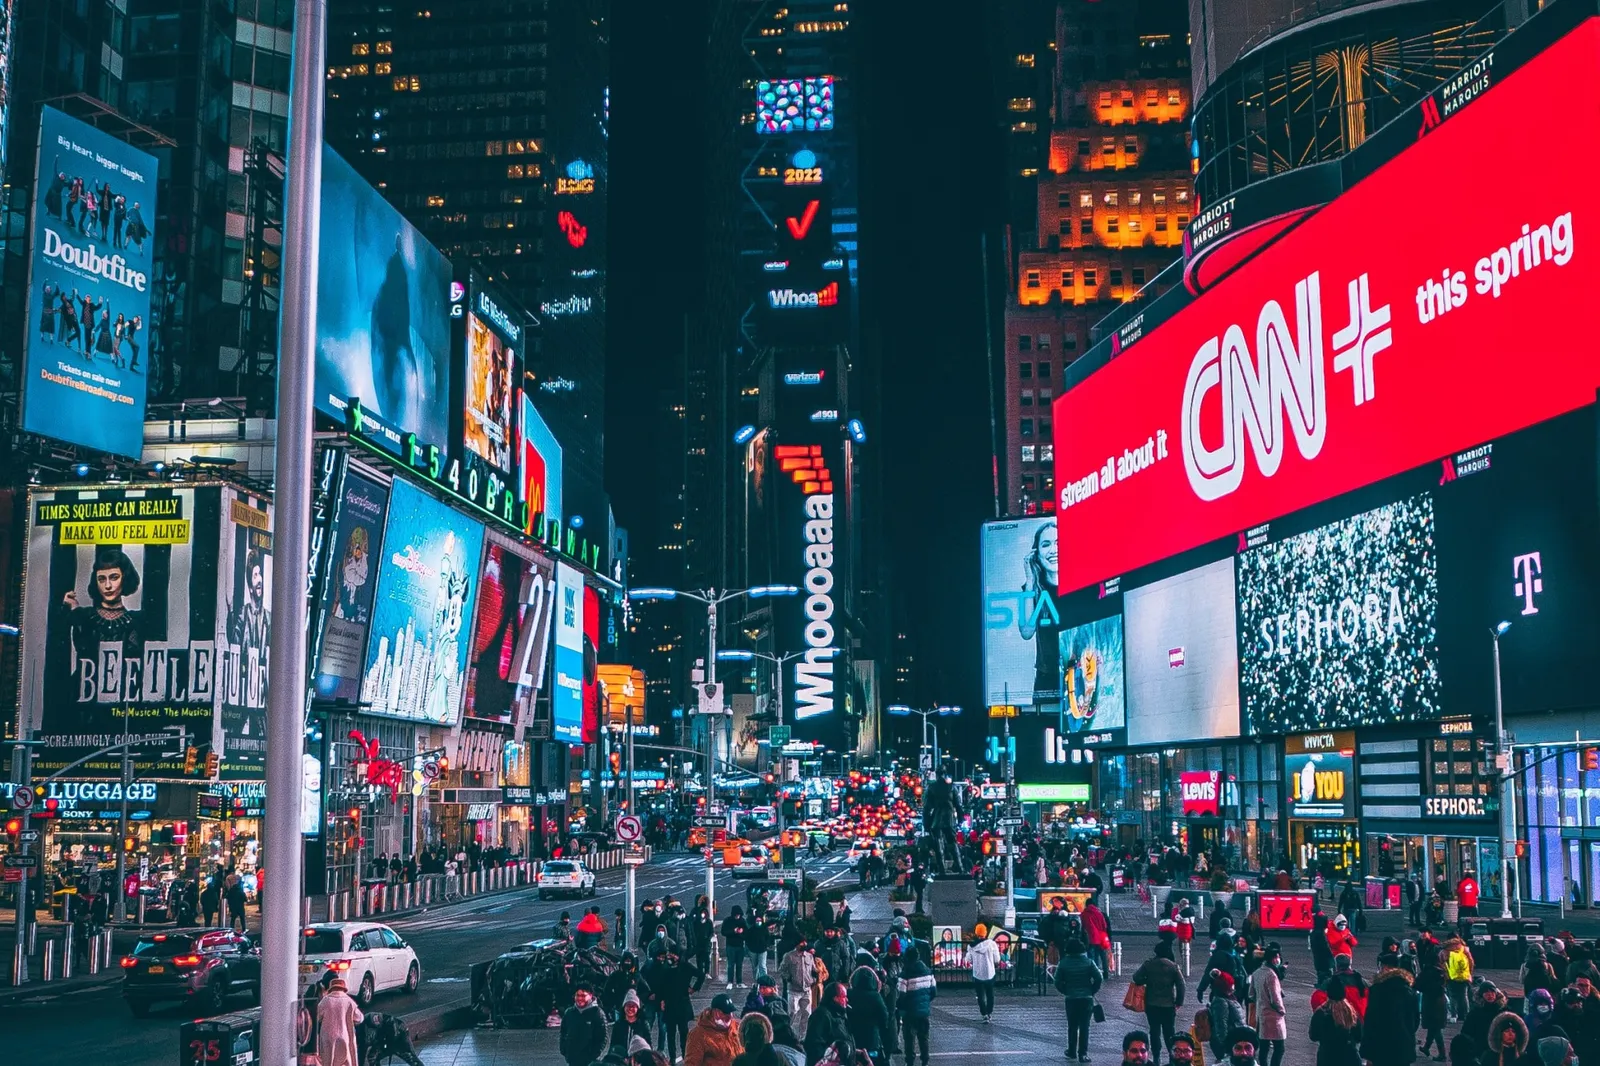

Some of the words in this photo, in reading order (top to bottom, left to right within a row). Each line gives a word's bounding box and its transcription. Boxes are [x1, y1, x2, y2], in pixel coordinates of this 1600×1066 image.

[1443, 54, 1494, 99] MARRIOTT
[1444, 75, 1489, 116] MARQUIS
[57, 134, 70, 150] Big
[72, 143, 94, 162] heart,
[95, 154, 119, 172] bigger
[120, 164, 145, 184] laughs.
[784, 168, 822, 185] 2022
[1192, 198, 1236, 234] MARRIOTT
[1193, 217, 1230, 249] MARQUIS
[43, 228, 147, 292] Doubtfire
[1416, 266, 1468, 325] this
[1474, 211, 1574, 298] spring
[450, 304, 462, 317] G
[41, 368, 134, 405] DoubtfireBroadway.com
[58, 361, 81, 377] Tickets
[82, 371, 91, 379] on
[91, 373, 105, 384] sale
[105, 378, 121, 388] now!
[785, 373, 820, 383] verizon
[1457, 444, 1493, 464] MARRIOTT
[1061, 471, 1099, 510] stream
[1100, 456, 1115, 490] all
[1117, 436, 1155, 481] about
[1156, 429, 1168, 461] it
[1457, 457, 1490, 477] MARQUIS
[40, 504, 70, 520] TIMES
[72, 502, 112, 520] SQUARE
[115, 501, 136, 516] CAN
[139, 499, 178, 515] REALLY
[408, 434, 478, 500] 1540
[486, 476, 600, 570] BROADWAY
[64, 525, 94, 540] MAKE
[99, 525, 119, 539] YOU
[122, 524, 148, 539] FEEL
[152, 524, 186, 539] ALIVE!
[607, 608, 615, 644] 1500
[1259, 585, 1406, 660] SEPHORA
[77, 644, 214, 703] BEETLE
[111, 707, 126, 717] The
[127, 707, 161, 717] Musical.
[164, 707, 179, 717] The
[181, 707, 213, 717] Musical.
[114, 733, 141, 746] GOOD
[1441, 721, 1473, 734] SEPHORA
[1304, 734, 1335, 749] INVICTA
[49, 782, 157, 800] LUGGAGE
[1315, 770, 1344, 799] YOU
[57, 799, 78, 809] NY
[62, 810, 93, 818] SONY
[1425, 797, 1486, 816] SEPHORA
